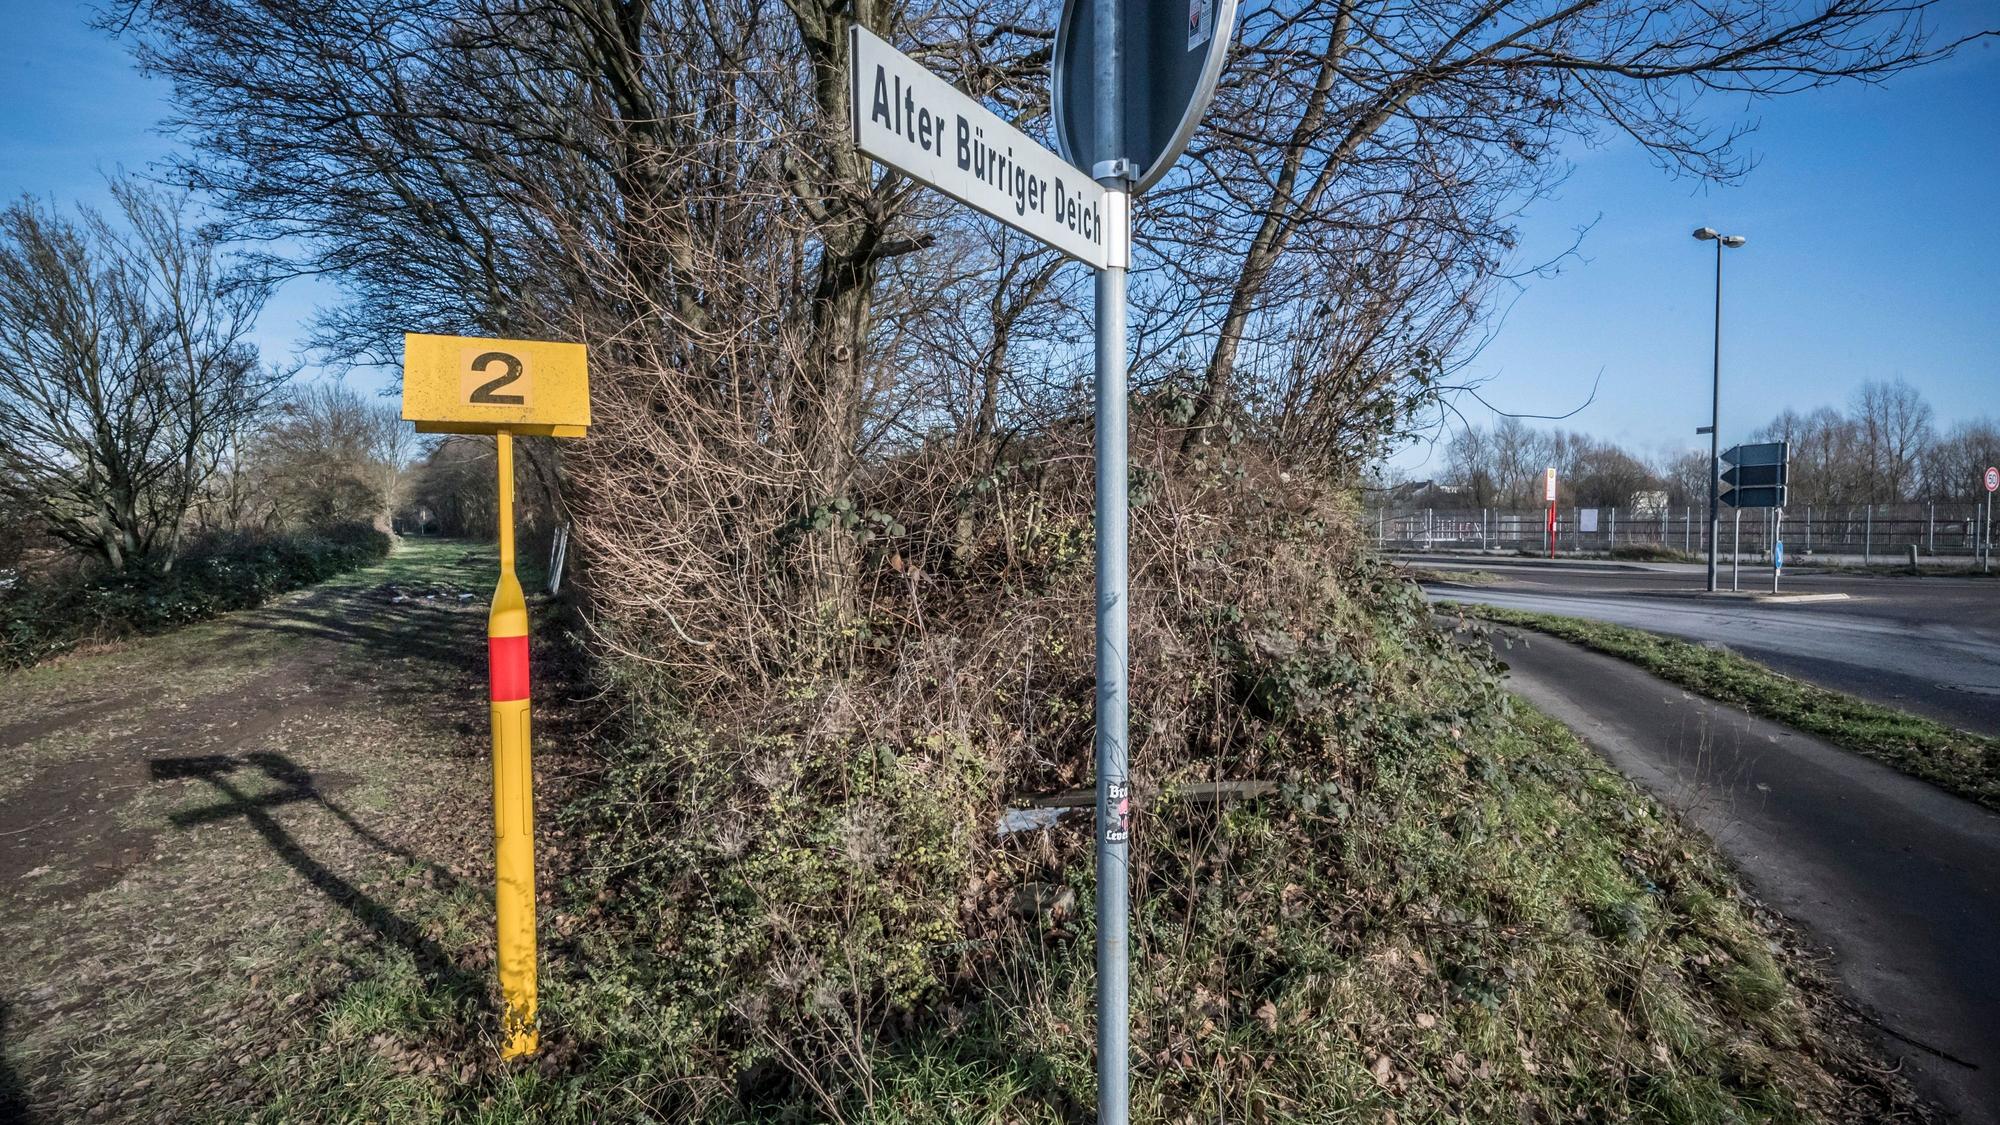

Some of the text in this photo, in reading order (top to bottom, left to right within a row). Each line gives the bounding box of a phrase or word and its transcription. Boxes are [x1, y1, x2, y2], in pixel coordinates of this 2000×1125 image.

[872, 64, 1101, 245] Alter Bürriger Deich
[469, 352, 524, 405] 2
[1988, 473, 1997, 485] 50
